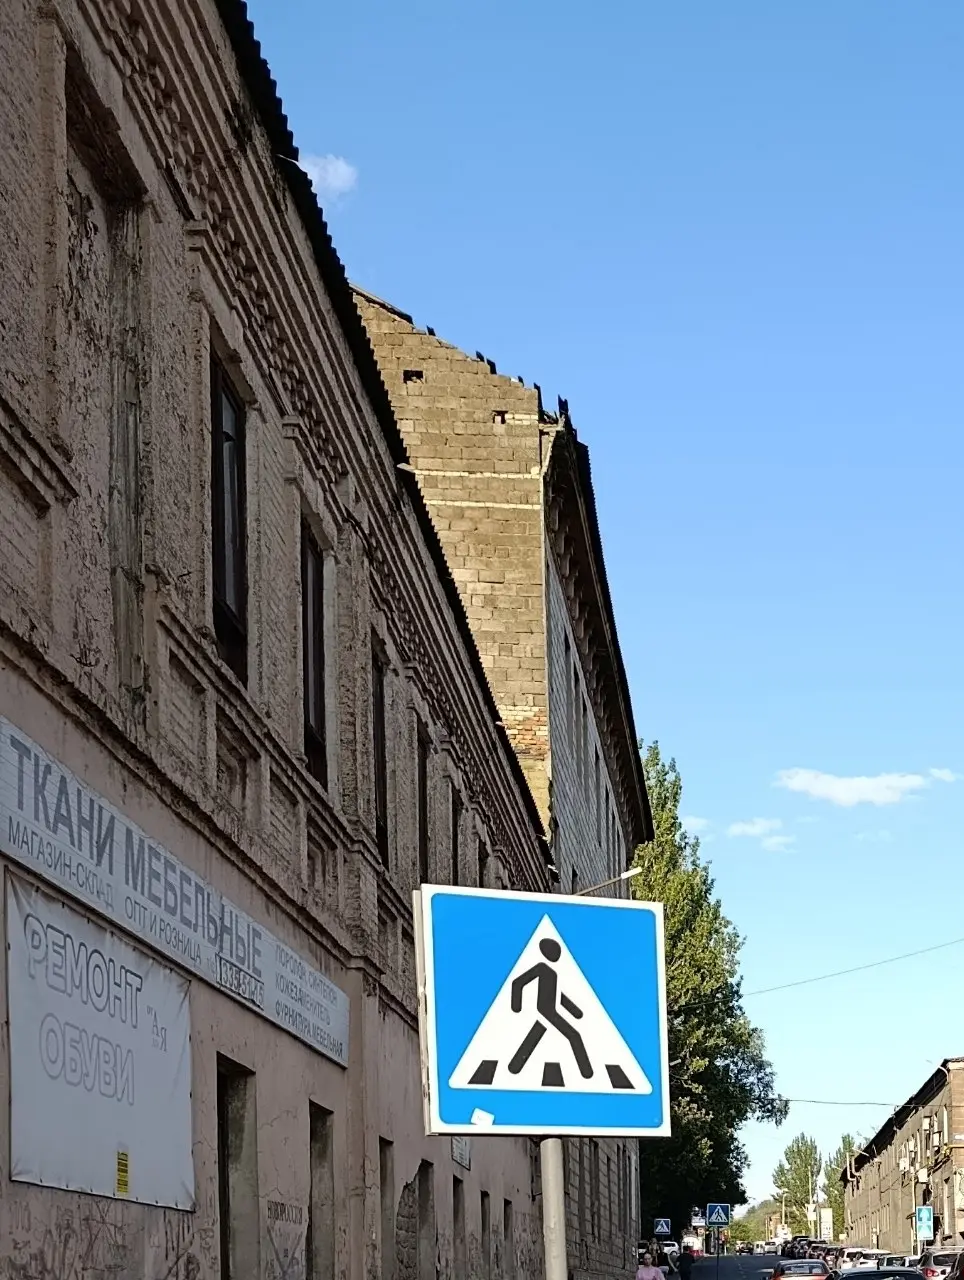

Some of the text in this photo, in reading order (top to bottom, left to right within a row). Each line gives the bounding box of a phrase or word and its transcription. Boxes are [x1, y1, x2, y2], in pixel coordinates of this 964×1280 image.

[8, 816, 115, 912] МАГАЗИН-СКЛАД
[125, 896, 148, 928] ОПТ
[160, 917, 201, 963] РОЗНИЦА
[10, 735, 262, 978] ТКАНИ МЕБЕЛЬНЫЕ
[24, 912, 143, 1029] РЕМОНТ
[39, 1013, 135, 1106] ОБУВИ
